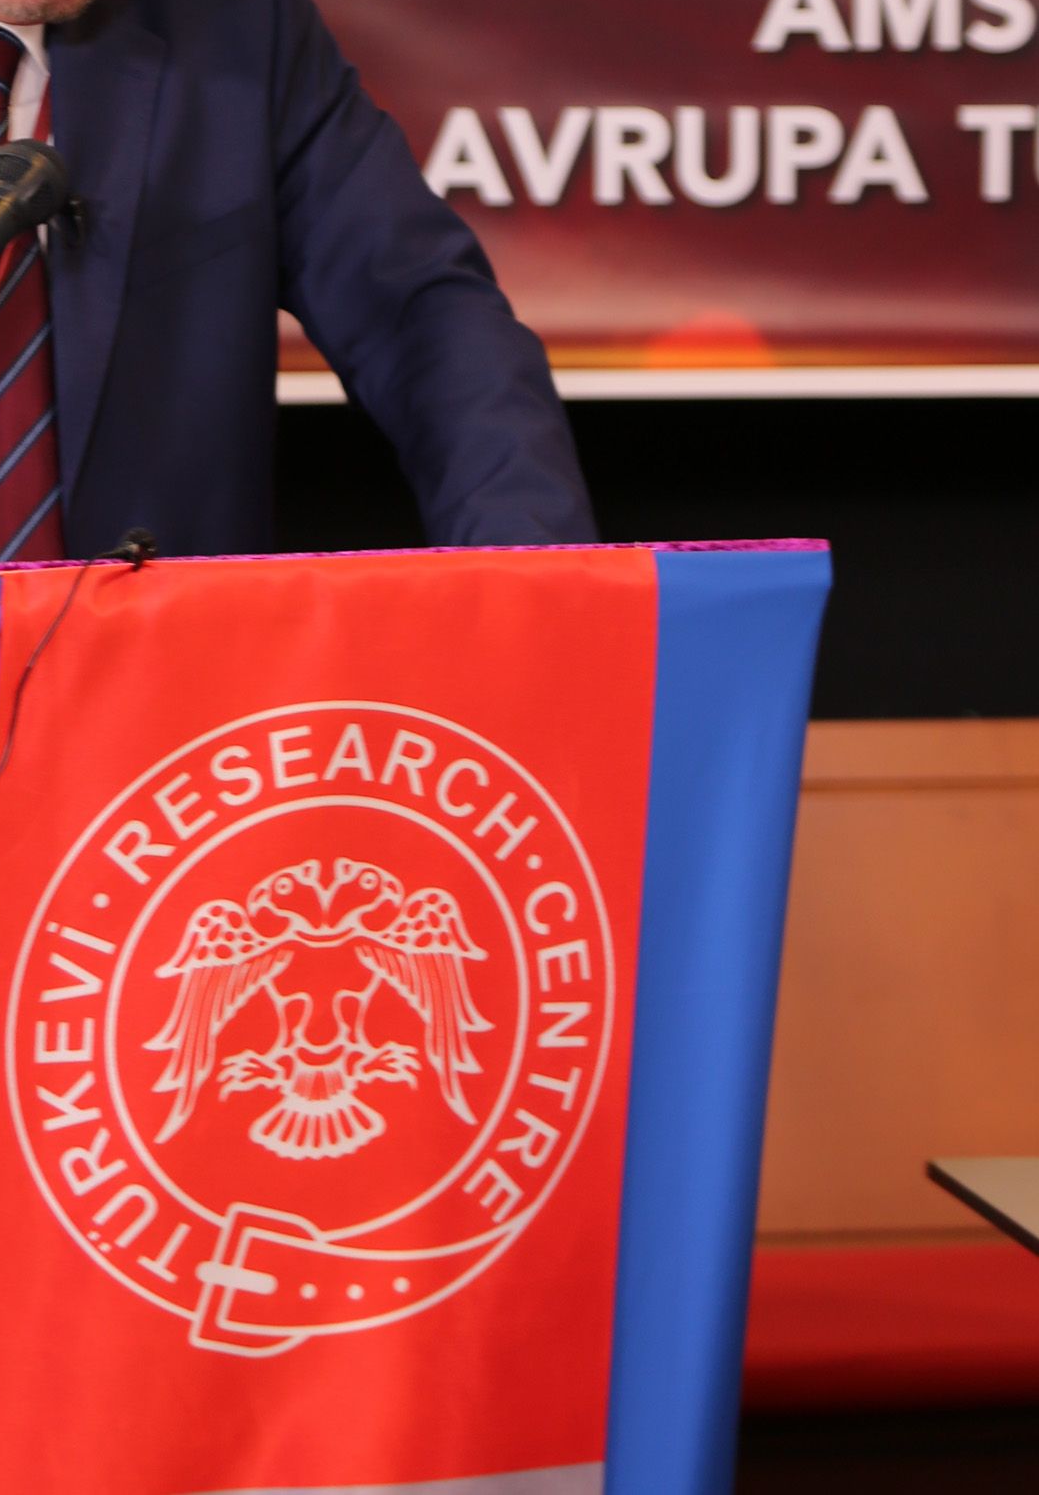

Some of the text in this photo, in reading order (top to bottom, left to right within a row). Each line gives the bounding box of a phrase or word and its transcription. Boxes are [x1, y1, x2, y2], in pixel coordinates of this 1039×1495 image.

[421, 104, 1039, 207] AVRUPA T
[102, 723, 539, 885] RESEARCH
[462, 880, 593, 1224] CENTRE
